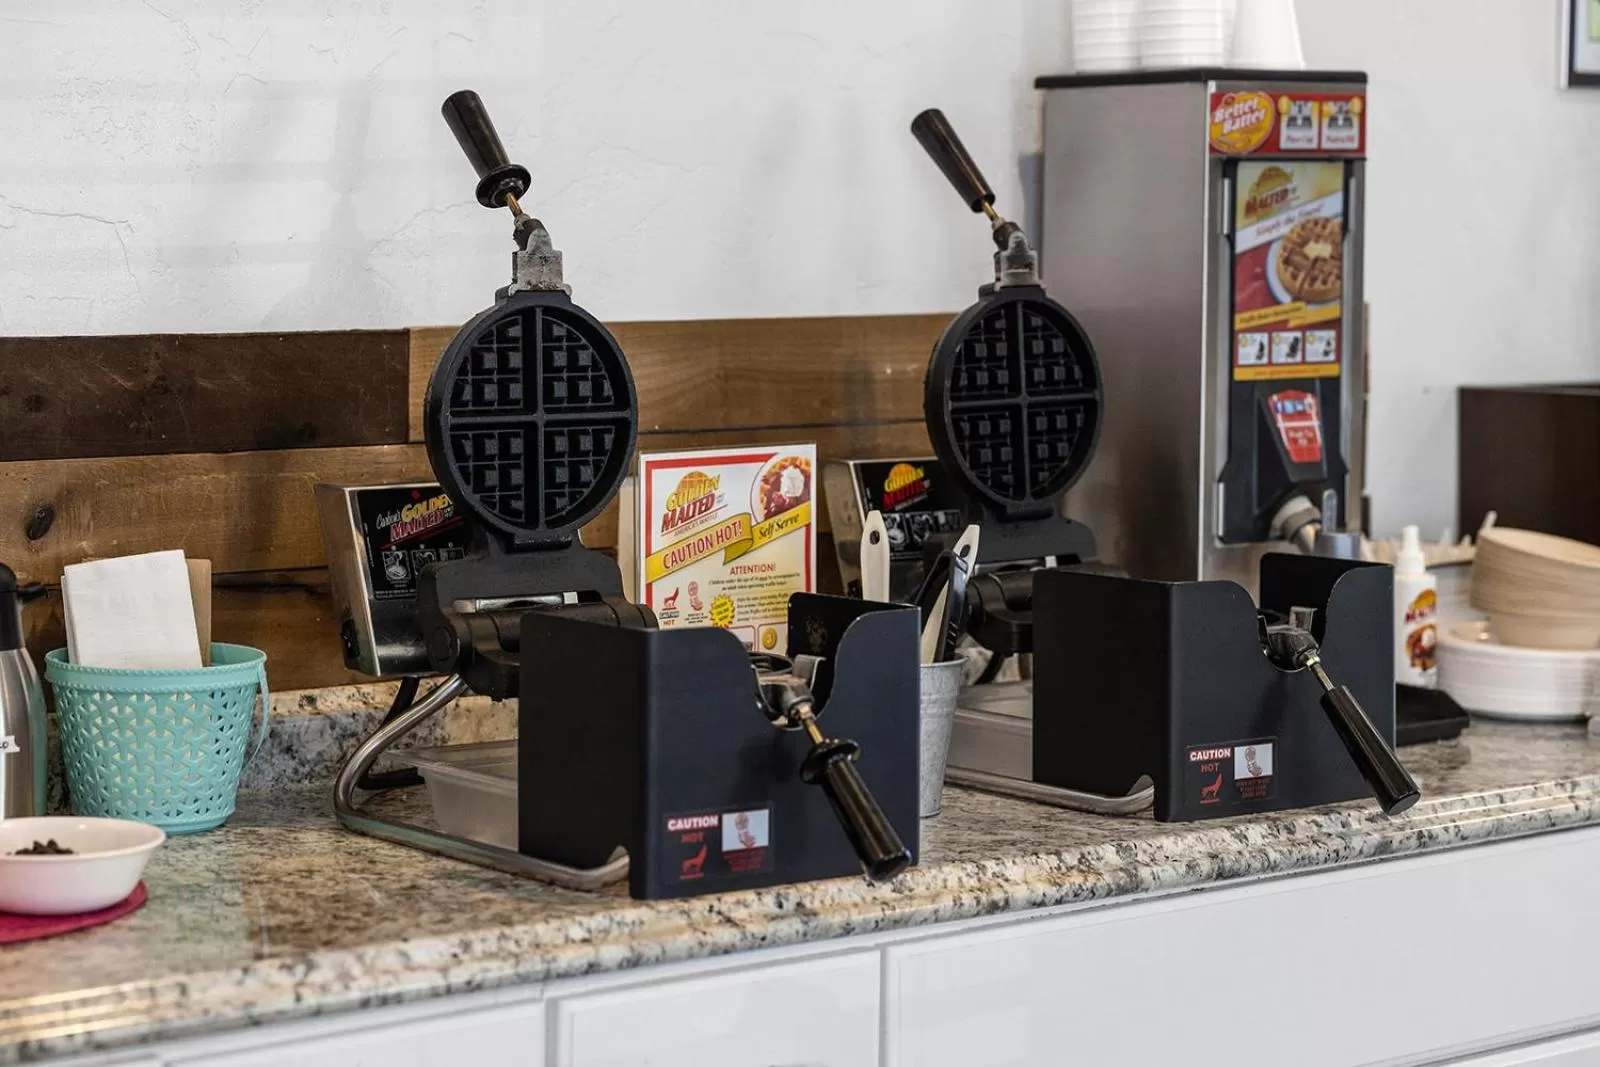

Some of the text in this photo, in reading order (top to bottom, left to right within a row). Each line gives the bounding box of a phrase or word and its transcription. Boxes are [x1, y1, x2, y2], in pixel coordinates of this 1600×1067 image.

[661, 492, 716, 532] MALTED
[758, 513, 800, 541] Self Serve
[663, 520, 743, 569] CAUTION HOT!
[730, 563, 776, 576] ATTENTION!
[1189, 747, 1231, 761] CAUTION
[1200, 762, 1220, 773] HOT
[667, 814, 719, 832] CAUTION
[681, 832, 704, 843] HOT
